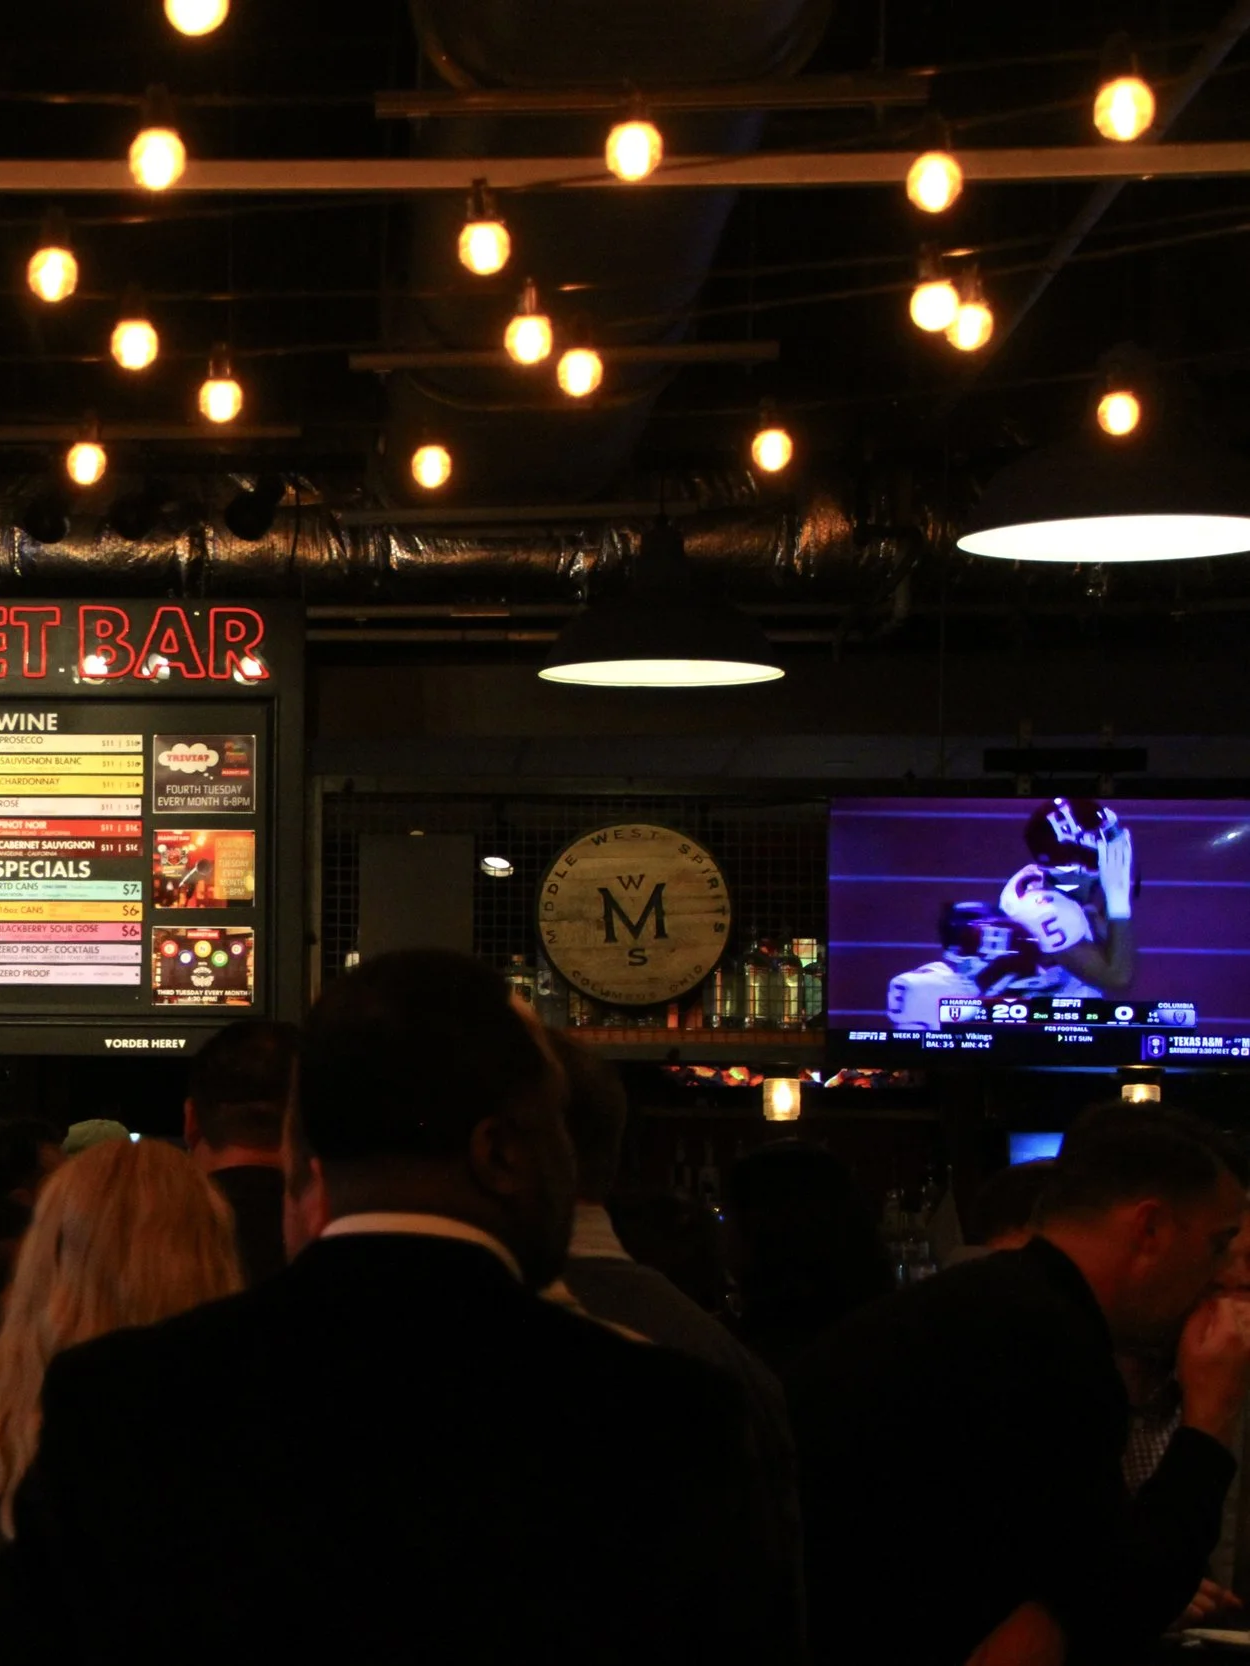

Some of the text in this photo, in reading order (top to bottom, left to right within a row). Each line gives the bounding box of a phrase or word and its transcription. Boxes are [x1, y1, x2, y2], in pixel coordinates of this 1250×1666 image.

[78, 606, 270, 679] BAR
[0, 736, 43, 744] PROSECCO
[0, 757, 52, 765] SAUVIGNON
[55, 757, 82, 765] BLANC
[166, 785, 242, 794] FOURTH TUESDAY
[158, 797, 250, 806] EVERY MONTH 6-8PM
[42, 841, 95, 849] SAUVIGNON
[591, 829, 660, 846] WEST
[678, 843, 726, 933] SPIRITS
[617, 874, 645, 890] W
[123, 884, 137, 895] $7
[21, 906, 43, 914] CANS
[123, 905, 137, 916] $6
[597, 883, 668, 943] M
[122, 925, 136, 937] $6
[1041, 917, 1066, 947] 5
[55, 946, 100, 954] COCKTAILS
[628, 949, 648, 966] S
[1052, 999, 1082, 1007] ESPN
[992, 1004, 1028, 1019] 20
[1114, 1006, 1134, 1020] 0
[925, 1032, 952, 1040] Ravens
[965, 1032, 993, 1041] Vikings
[1174, 1036, 1201, 1047] TEXAS
[1202, 1037, 1223, 1047] A&M
[113, 1039, 178, 1048] ORDER HERE
